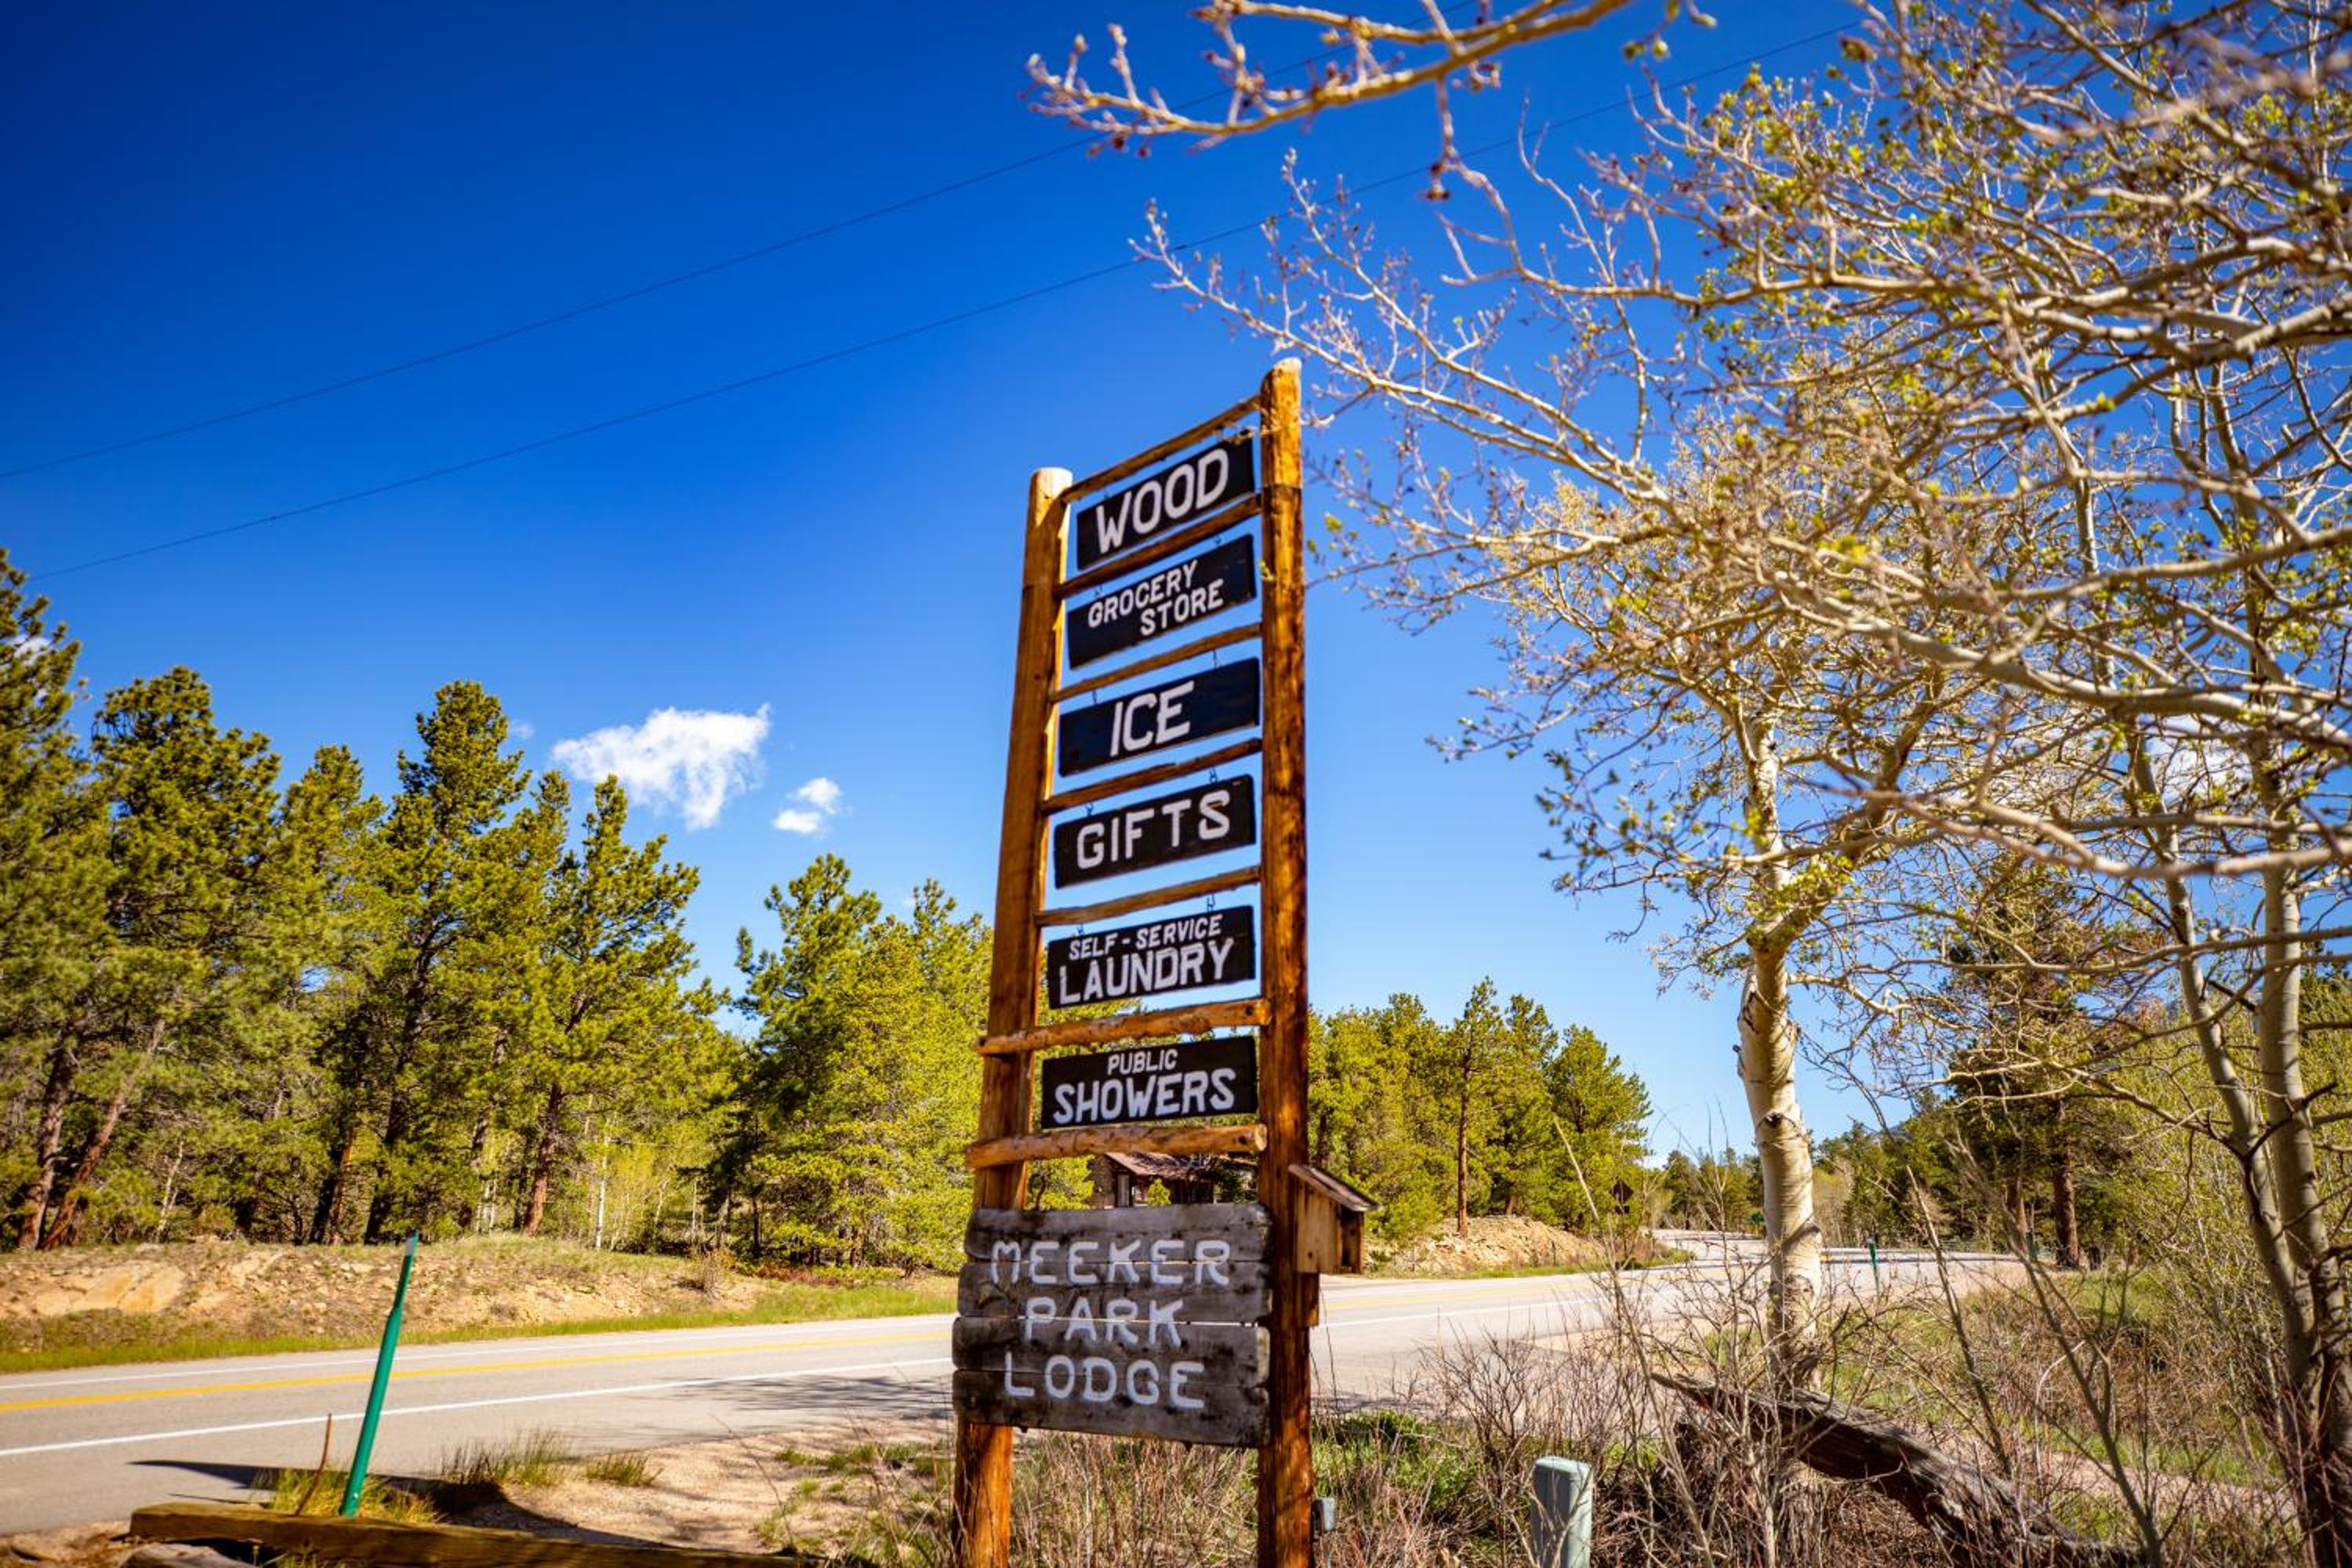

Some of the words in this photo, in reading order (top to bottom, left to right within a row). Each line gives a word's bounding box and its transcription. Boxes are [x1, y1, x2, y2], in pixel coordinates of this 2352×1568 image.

[1096, 448, 1229, 554] WOOD
[1087, 560, 1197, 628] GROCERY
[1140, 579, 1225, 637] STORE
[1109, 681, 1195, 757] ICE
[1076, 789, 1231, 869] GIFTS
[1059, 938, 1234, 1005] LAUNDRY
[1107, 1048, 1178, 1075] PUBLIC
[1052, 1068, 1237, 1124] SHOWERS
[989, 1240, 1232, 1287] MEEKER
[1025, 1295, 1185, 1347] PARK
[1004, 1352, 1206, 1410] LODGE
